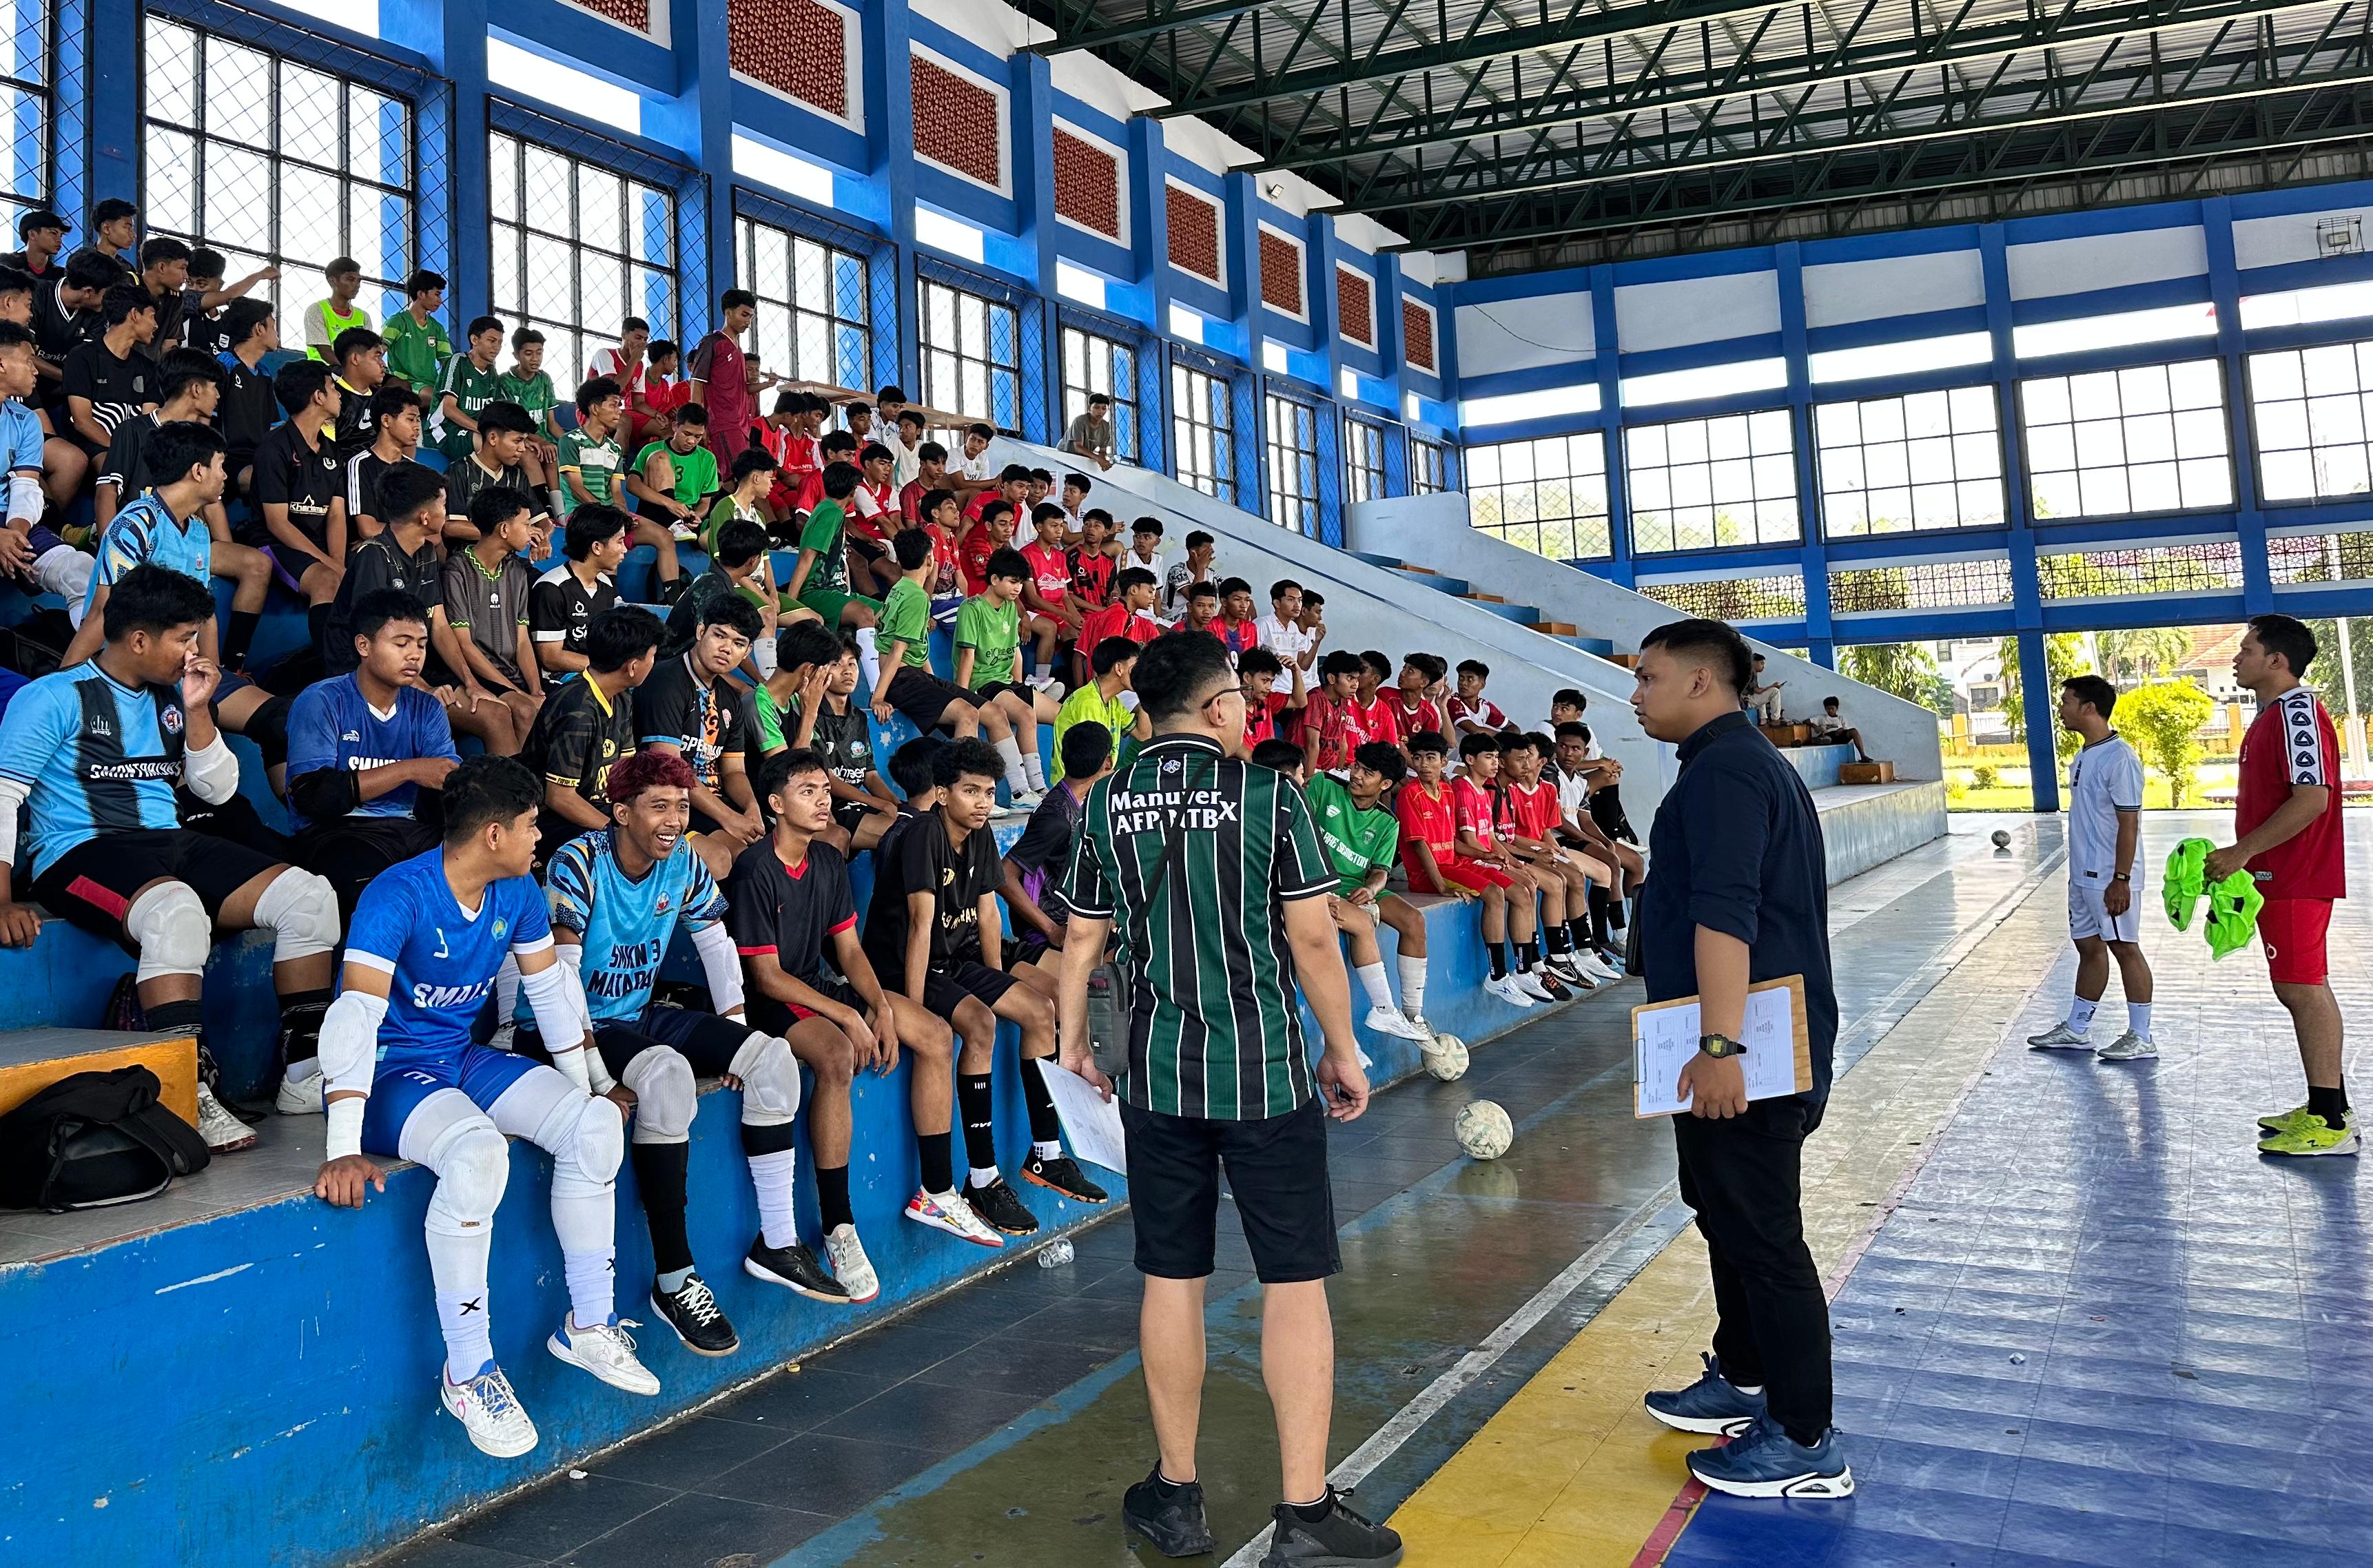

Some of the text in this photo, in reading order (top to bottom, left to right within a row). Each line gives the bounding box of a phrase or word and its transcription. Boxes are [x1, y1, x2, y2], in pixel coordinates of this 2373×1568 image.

[1230, 650, 1239, 670] 9
[1116, 809, 1160, 836] AFP
[608, 938, 661, 969] SMKN 3
